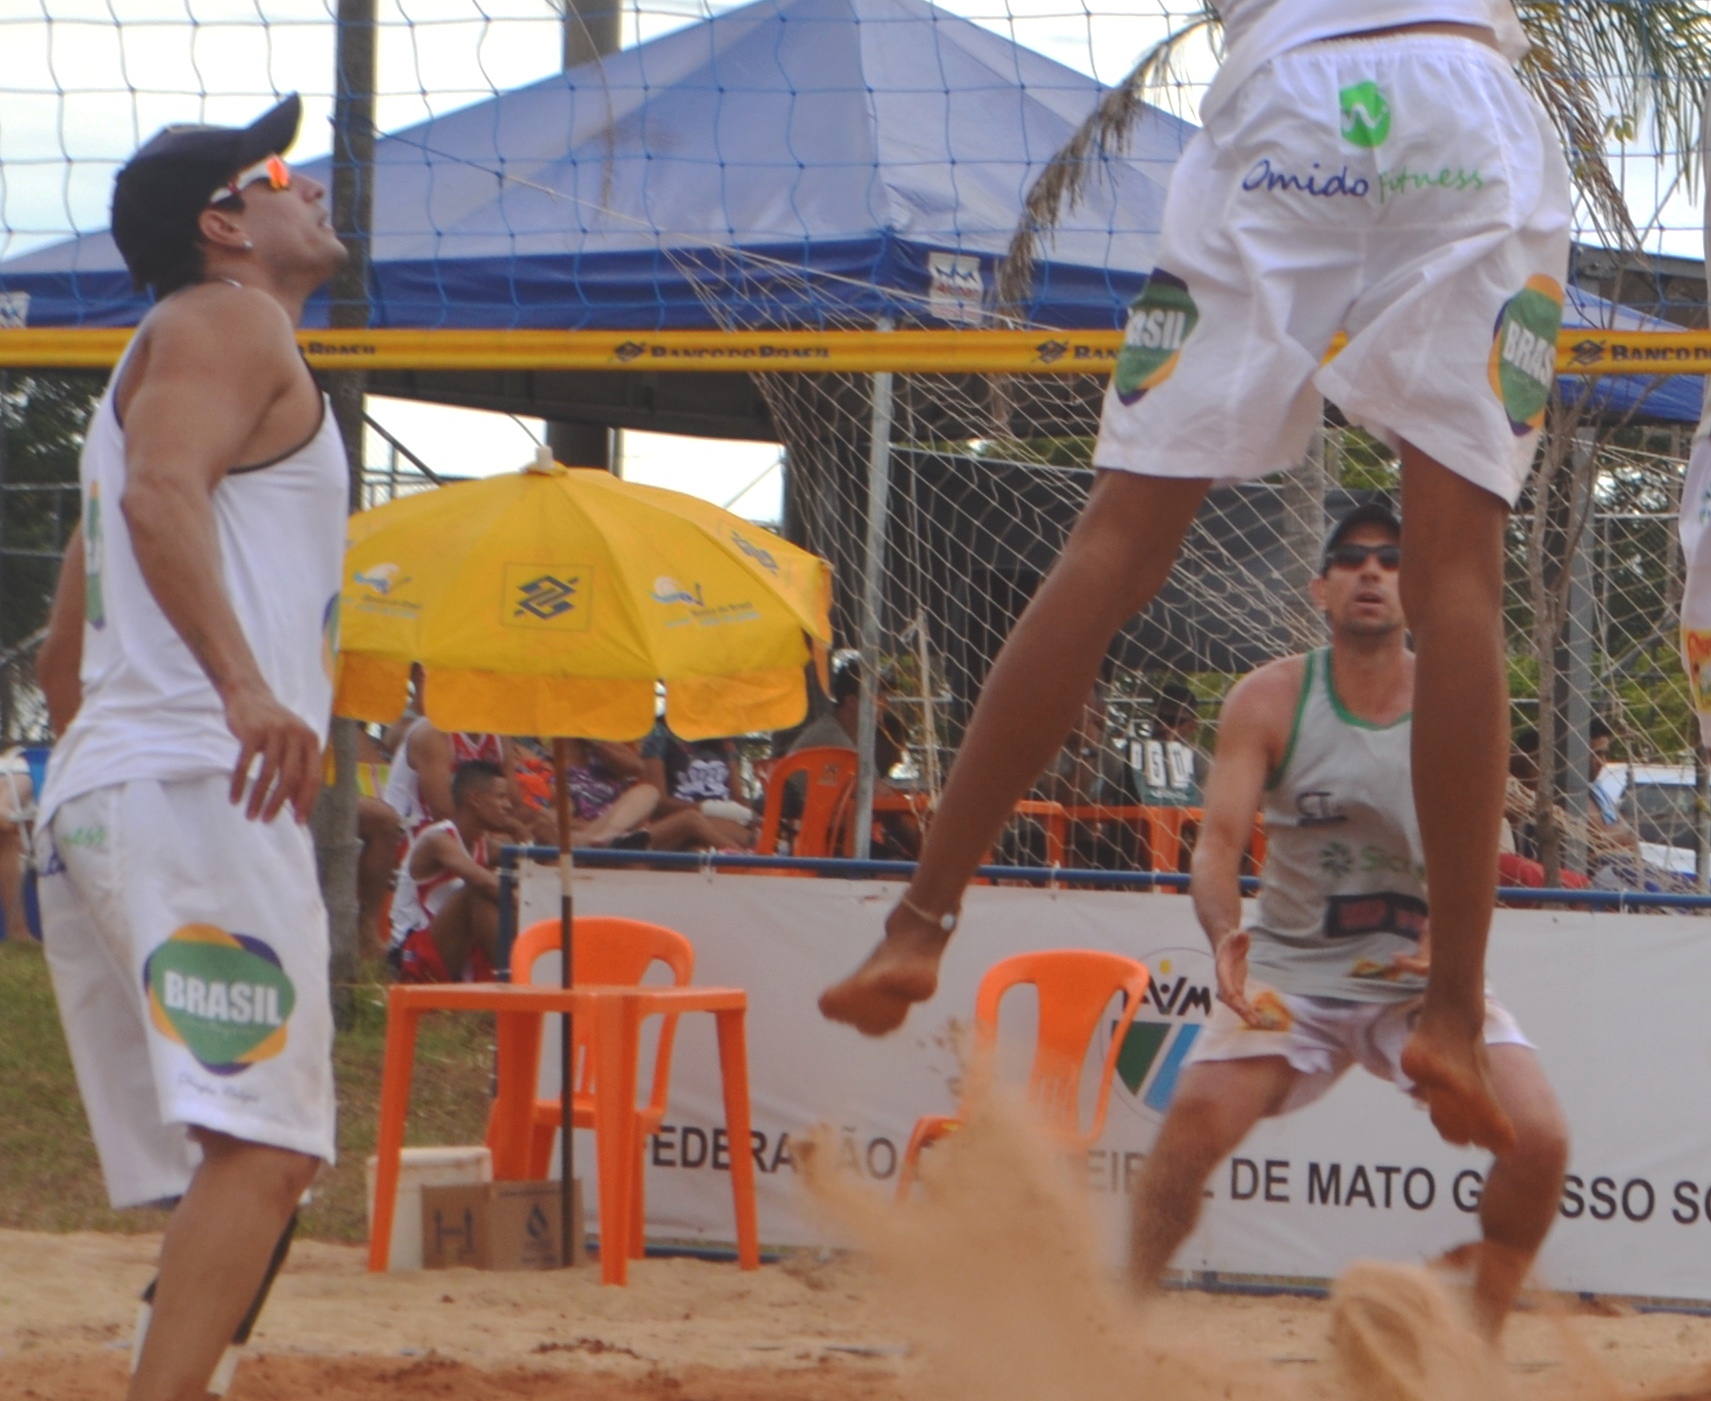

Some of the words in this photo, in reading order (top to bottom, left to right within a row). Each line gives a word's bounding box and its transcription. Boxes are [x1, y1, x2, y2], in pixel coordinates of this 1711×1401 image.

[1242, 158, 1370, 199] Omido
[163, 970, 282, 1026] BRASIL
[1231, 1158, 1291, 1203] DE
[1307, 1162, 1437, 1210] MATO
[1452, 1168, 1656, 1221] GSSO
